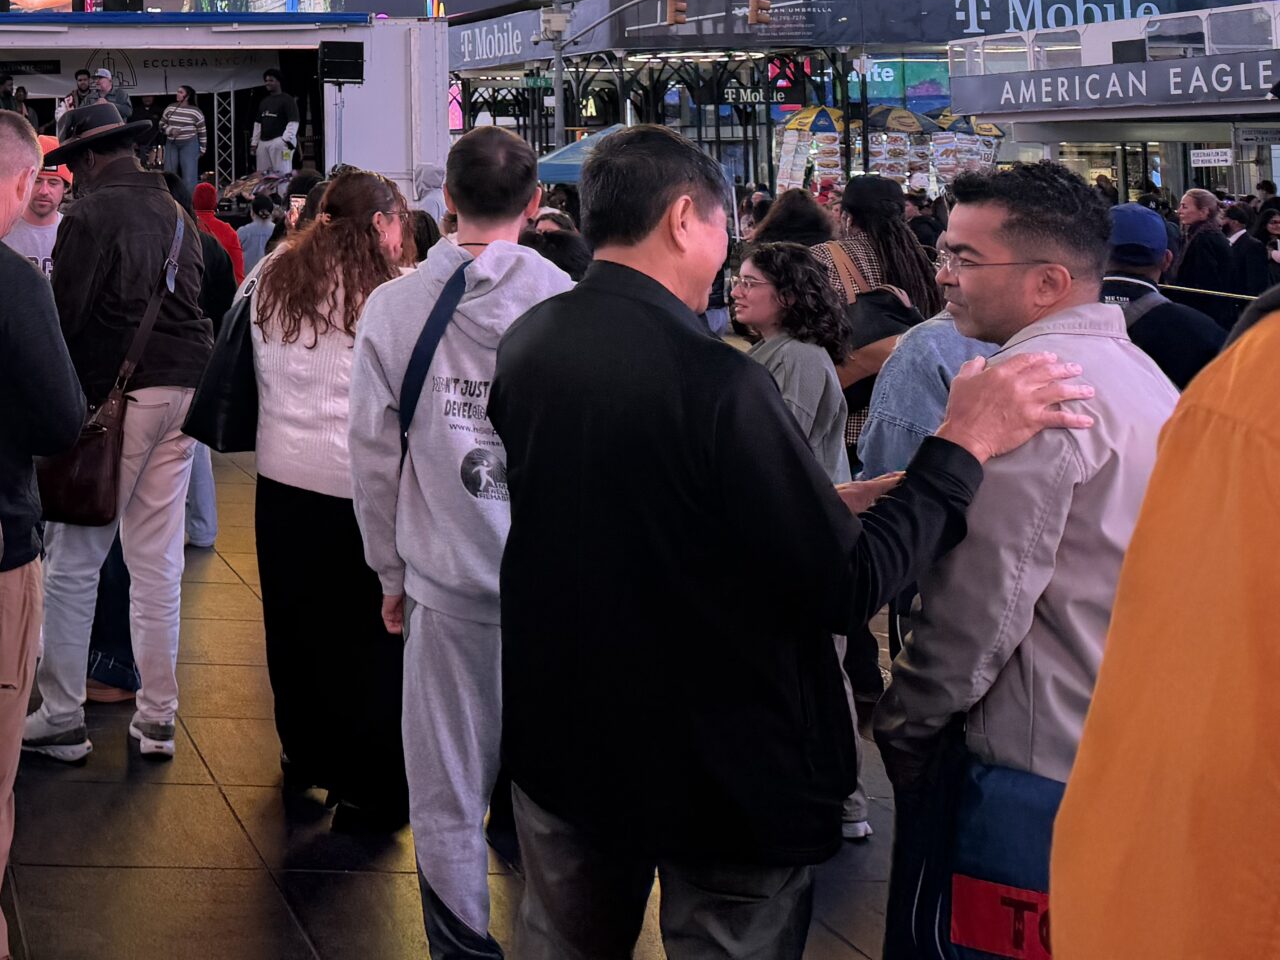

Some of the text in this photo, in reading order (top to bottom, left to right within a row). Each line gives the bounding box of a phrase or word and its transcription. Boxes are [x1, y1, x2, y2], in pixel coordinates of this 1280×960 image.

[474, 22, 522, 60] Mobile
[143, 58, 208, 69] ECCLESIA
[999, 59, 1273, 106] AMERICAN EAGLE
[739, 88, 785, 102] Mole
[460, 380, 491, 398] JUST
